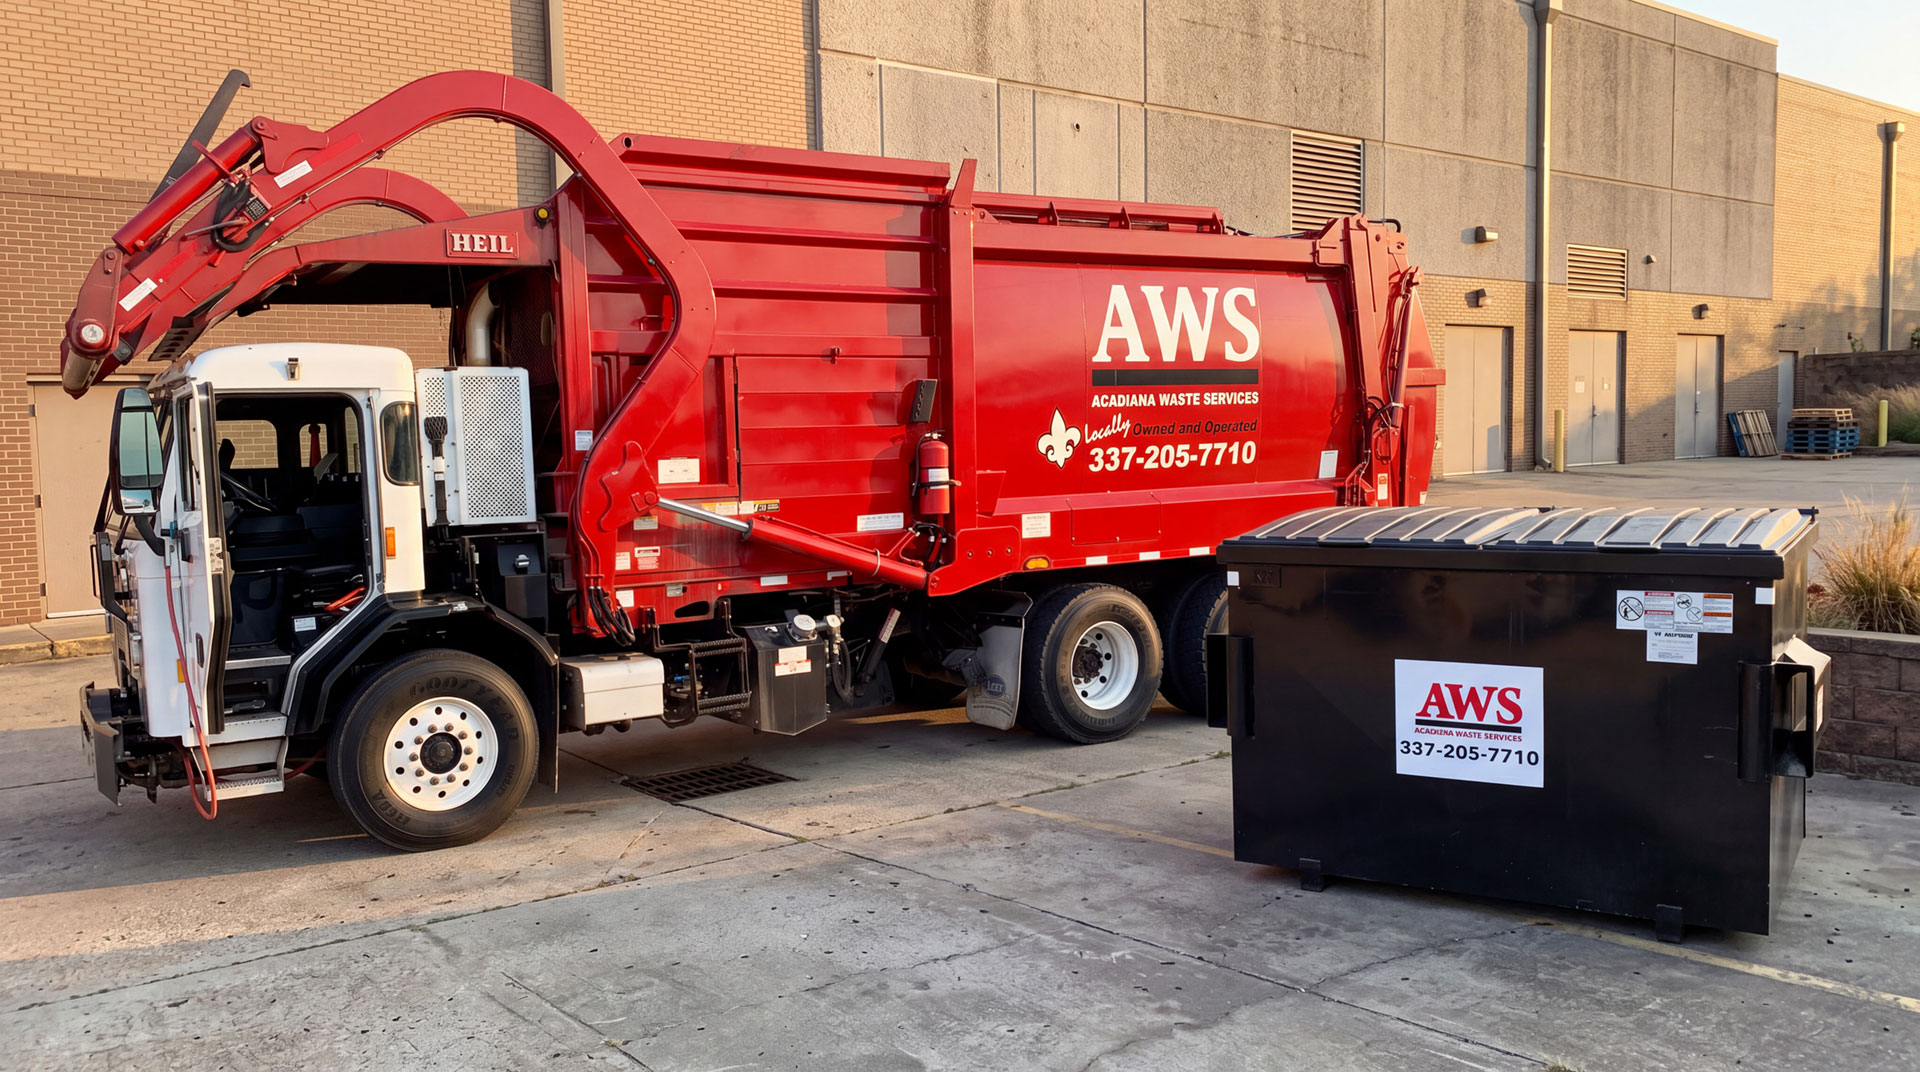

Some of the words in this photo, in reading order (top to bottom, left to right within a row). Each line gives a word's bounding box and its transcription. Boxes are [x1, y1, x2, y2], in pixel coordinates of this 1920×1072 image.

[452, 233, 513, 253] HEIL
[1092, 285, 1260, 362] AWS
[1091, 394, 1156, 407] ACADIANA
[1159, 392, 1201, 406] WASTE
[1203, 391, 1259, 405] SERVICES
[1084, 412, 1131, 444] Locally
[1132, 421, 1176, 436] Owned
[1178, 421, 1201, 434] and
[1204, 419, 1258, 436] Operated
[1088, 441, 1257, 473] 337-205-7710
[1415, 682, 1523, 725] AWS
[1455, 731, 1482, 739] WASTE
[1484, 733, 1522, 742] SERVICES
[1400, 740, 1540, 766] 337-205-7710
